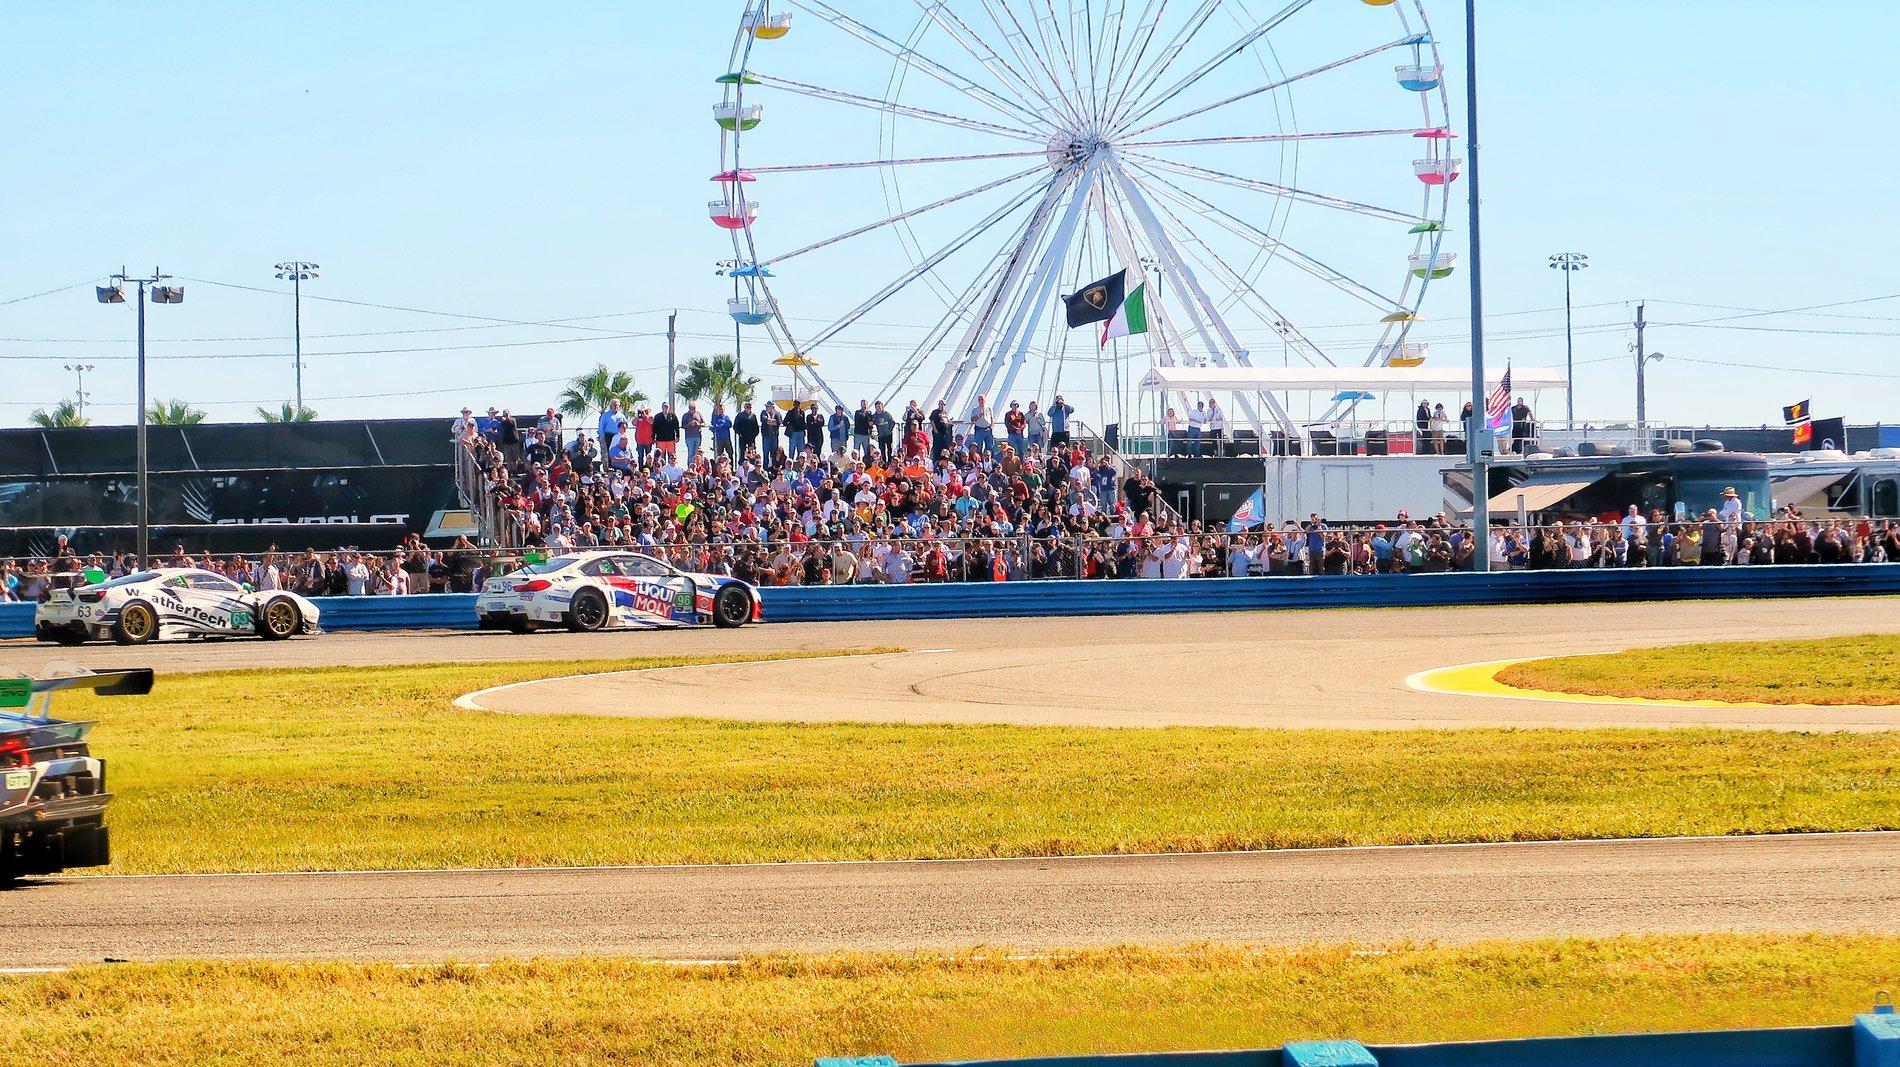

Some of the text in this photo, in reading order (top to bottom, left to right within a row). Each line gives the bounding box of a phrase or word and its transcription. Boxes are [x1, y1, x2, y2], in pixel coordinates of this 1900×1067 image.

[502, 581, 512, 591] 96
[638, 582, 675, 603] LIQUI
[635, 595, 671, 618] MOLY
[677, 594, 691, 606] 96
[78, 605, 91, 618] 63
[125, 588, 227, 628] WatherTech
[233, 612, 247, 624] 63
